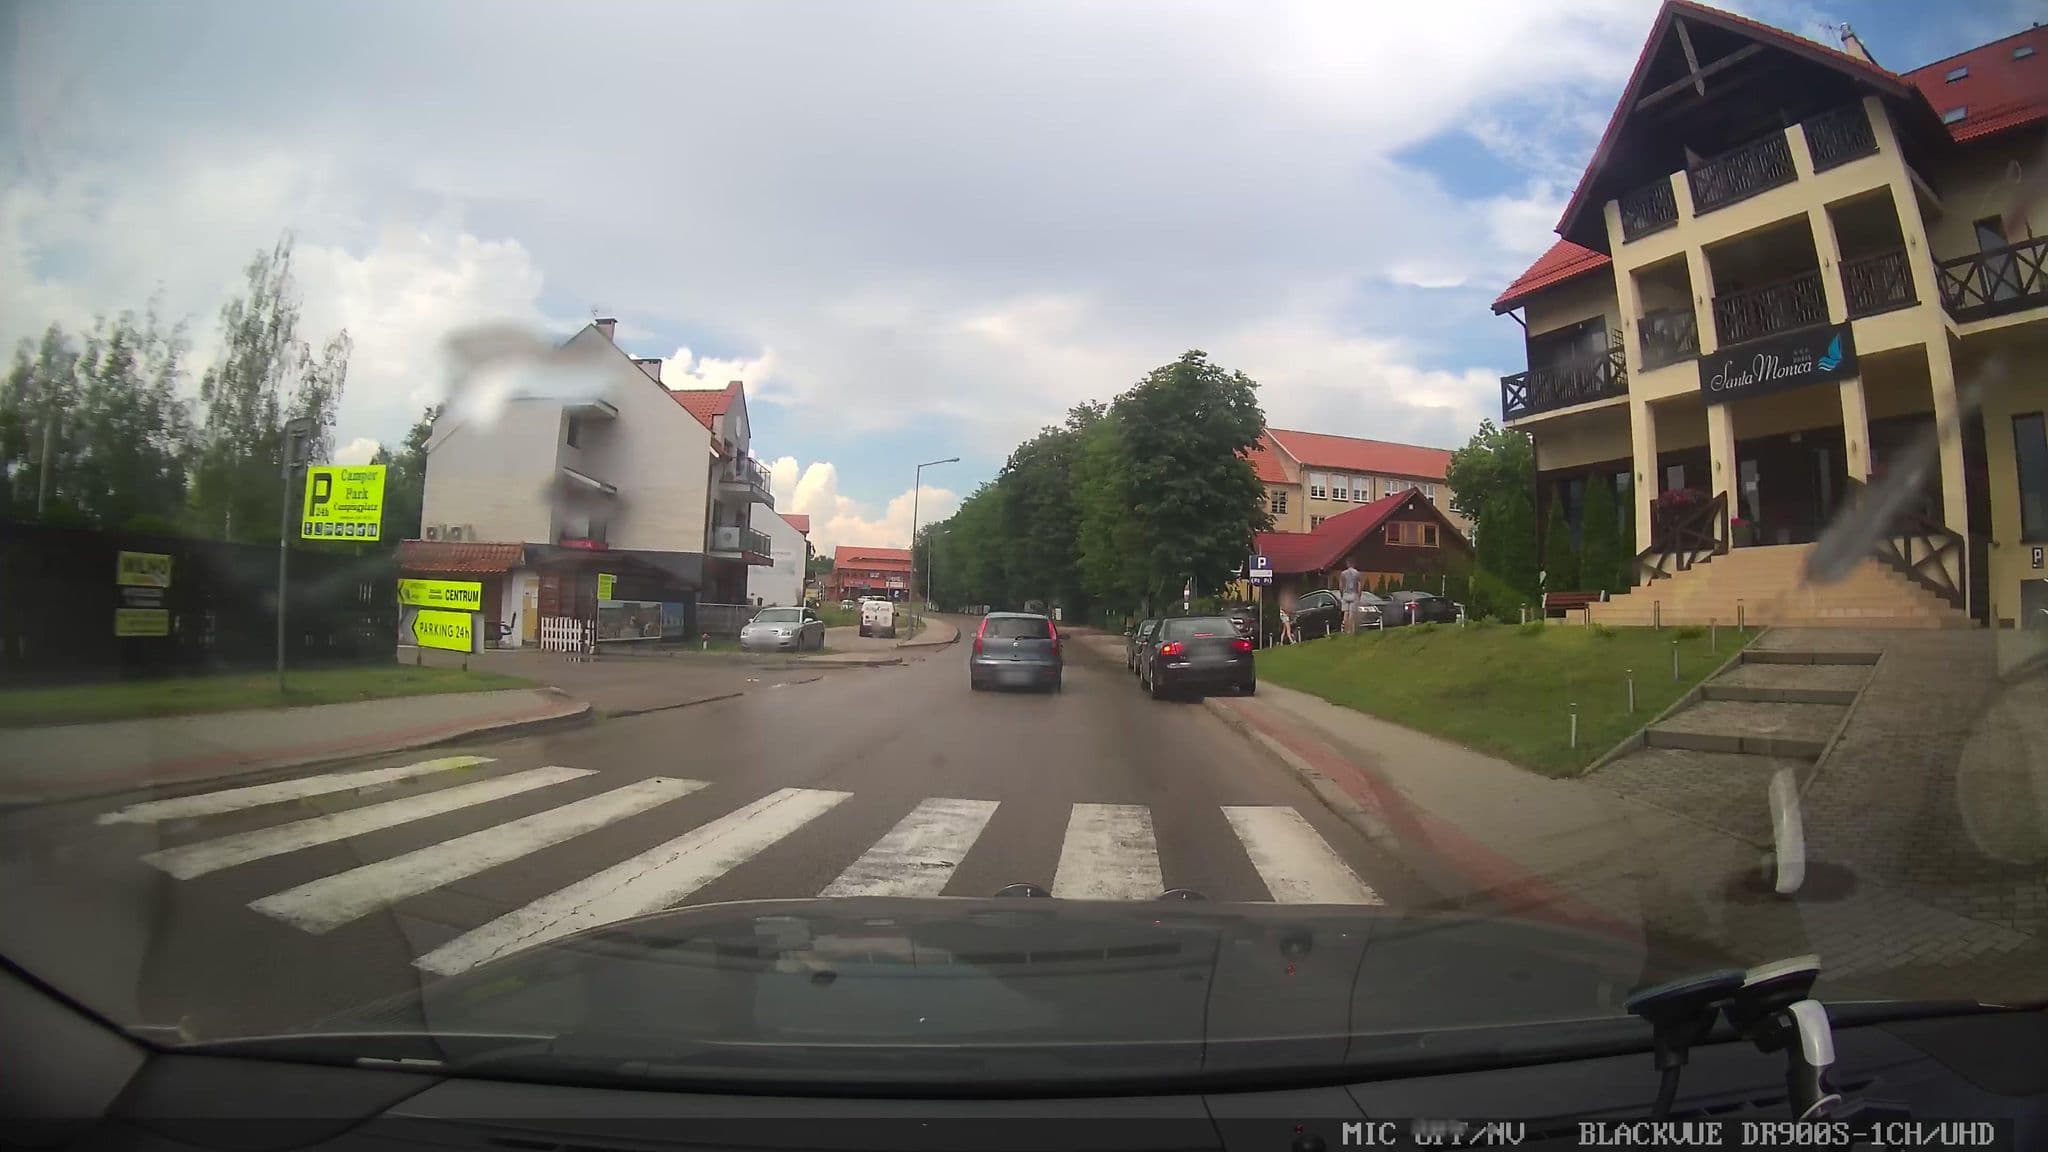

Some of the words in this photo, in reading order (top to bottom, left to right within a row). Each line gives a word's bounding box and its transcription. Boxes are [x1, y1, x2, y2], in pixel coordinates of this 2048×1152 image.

[1710, 360, 1753, 392] Santa
[1752, 353, 1812, 382] Monica
[341, 469, 378, 485] Camper
[345, 487, 369, 500] Park
[1258, 557, 1266, 568] P
[445, 589, 479, 602] CENTRUM
[419, 622, 453, 638] PARKING
[455, 625, 470, 640] 24h
